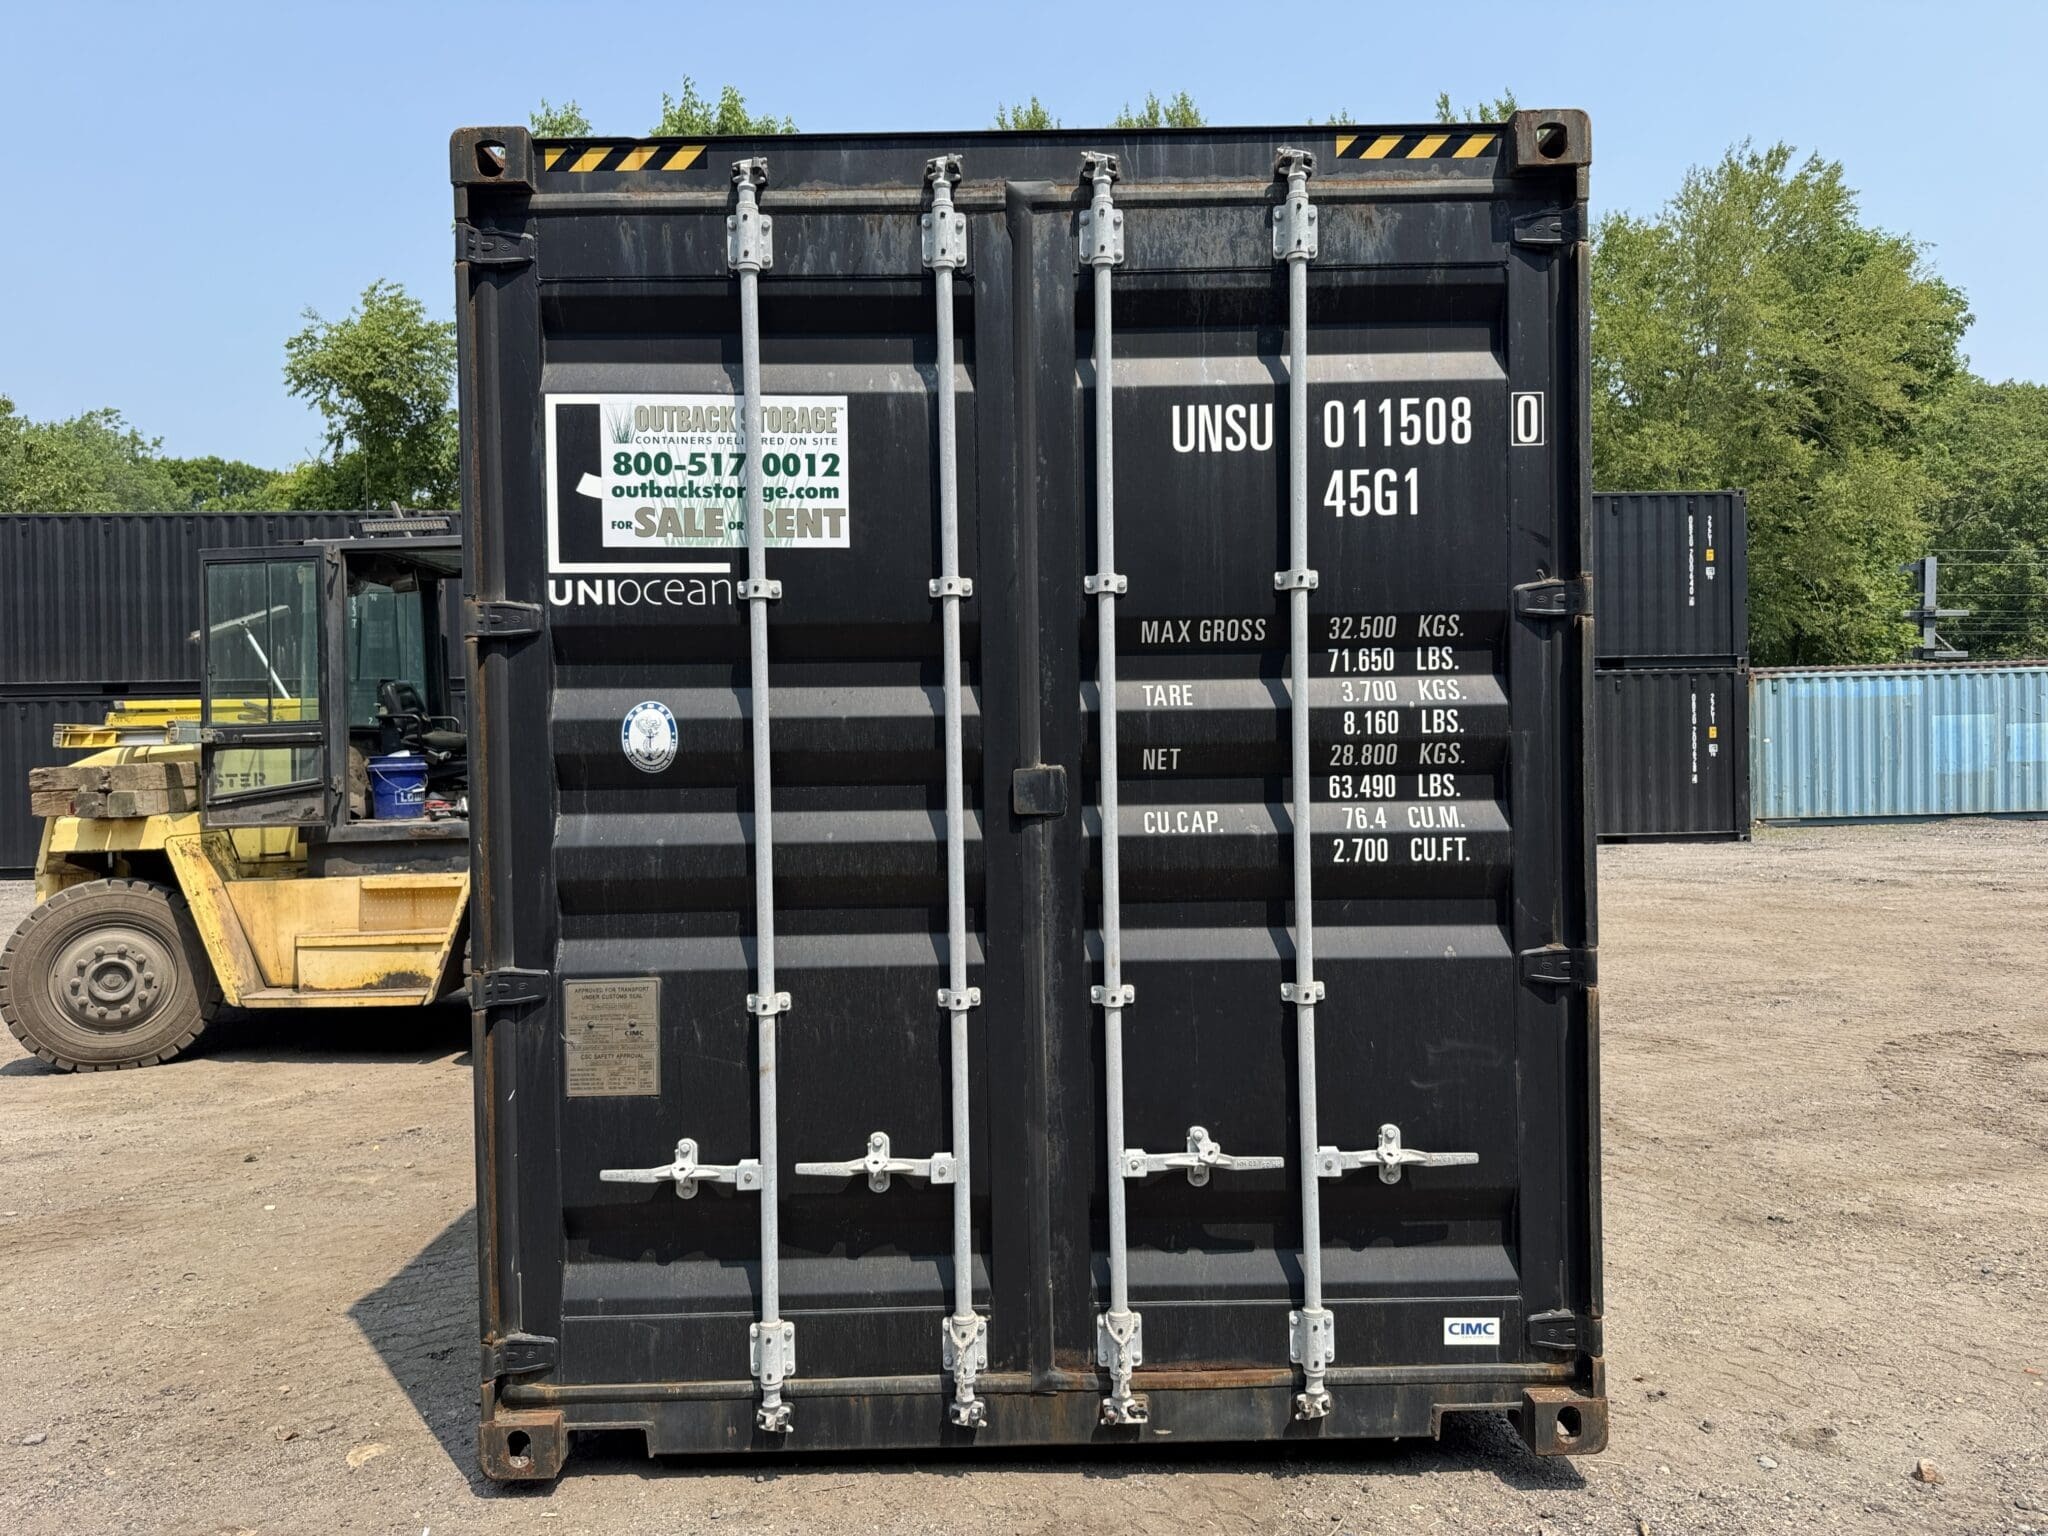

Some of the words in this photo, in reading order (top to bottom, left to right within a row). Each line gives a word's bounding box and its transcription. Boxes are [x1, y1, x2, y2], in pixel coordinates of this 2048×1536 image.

[634, 406, 736, 433] OUTBACK
[1172, 403, 1273, 452] UNSU
[1323, 396, 1472, 448] 011508
[1516, 394, 1539, 443] 0
[635, 436, 713, 446] CONTAINERS
[718, 436, 784, 446] DELIRED
[790, 437, 808, 446] ON
[813, 437, 838, 446] SITE
[612, 451, 841, 478] 800-5170012
[611, 480, 840, 502] outbackstorge.com
[1323, 467, 1418, 518] 45G1
[611, 521, 633, 530] FOR
[634, 506, 724, 538] SALE
[728, 521, 745, 530] OR
[1141, 620, 1191, 644] MAX
[1199, 618, 1267, 642] GROSS
[1417, 614, 1465, 638] KGS.
[1416, 646, 1460, 671] LBS.
[1142, 684, 1194, 706] TARE
[1417, 679, 1467, 700] KGS.
[1421, 709, 1465, 734] LBS.
[1143, 749, 1182, 771] NET
[1419, 742, 1466, 765] KGS.
[1418, 773, 1461, 798] LBS.
[1143, 811, 1225, 834] CU.CAP.
[1341, 806, 1387, 829] 76.4
[1407, 806, 1466, 829] CU.M.
[1410, 837, 1471, 862] CU.FT.
[1448, 1322, 1495, 1336] CIMC
